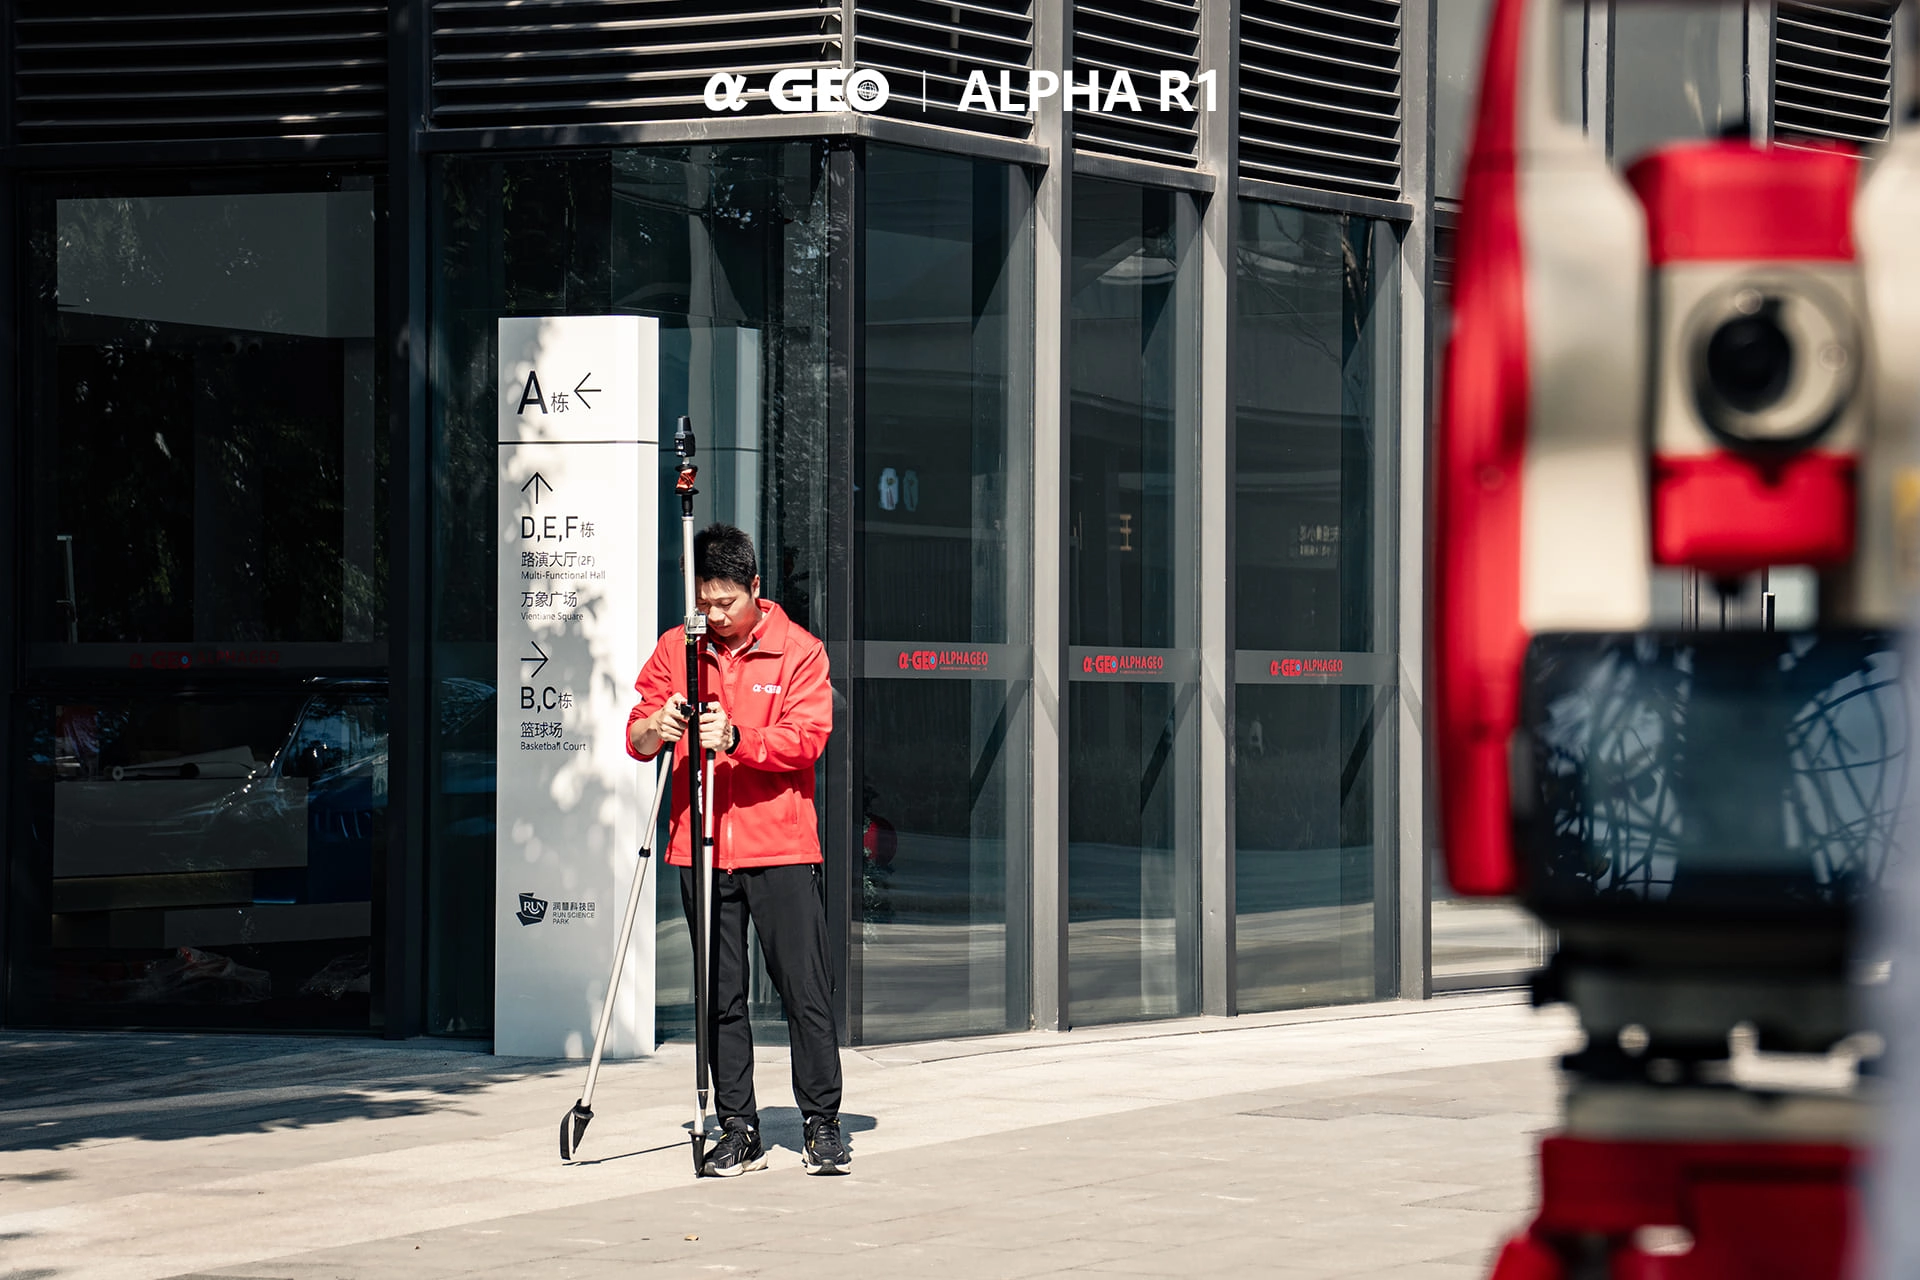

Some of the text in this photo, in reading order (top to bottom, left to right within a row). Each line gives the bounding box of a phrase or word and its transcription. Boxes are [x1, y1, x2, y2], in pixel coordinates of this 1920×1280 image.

[521, 570, 606, 580] Multi-Functional Hall
[521, 591, 577, 608] 万象广场
[521, 611, 584, 623] Vientiane Square
[939, 651, 989, 666] ALPHAGEO
[1119, 655, 1164, 669] ALPHAGEO
[1303, 659, 1343, 672] ALPHAGEO
[520, 721, 563, 739] 篮球场
[520, 741, 586, 751] Basketball Court
[523, 901, 545, 915] RUN
[552, 911, 595, 919] RUN SCIENCE
